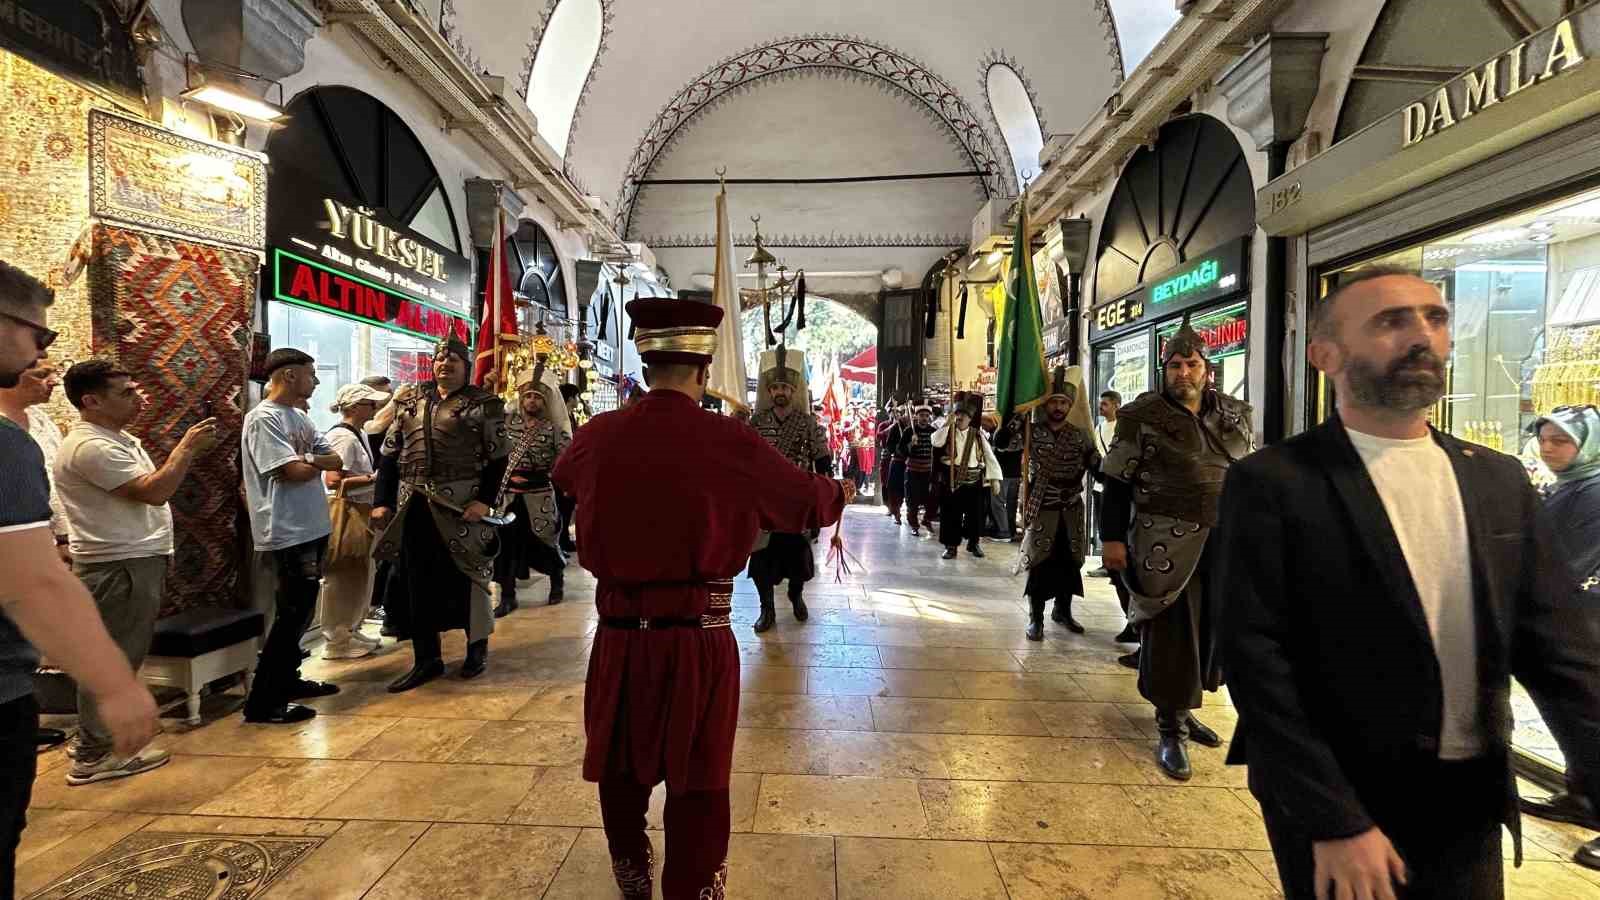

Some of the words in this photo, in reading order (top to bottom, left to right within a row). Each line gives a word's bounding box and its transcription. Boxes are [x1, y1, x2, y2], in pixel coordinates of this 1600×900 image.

[1402, 19, 1584, 148] DAMLA
[322, 198, 449, 284] YÜKSEL
[290, 263, 386, 322] ALTIN
[1153, 261, 1218, 303] BEYDAĞI
[1098, 299, 1126, 331] EGE
